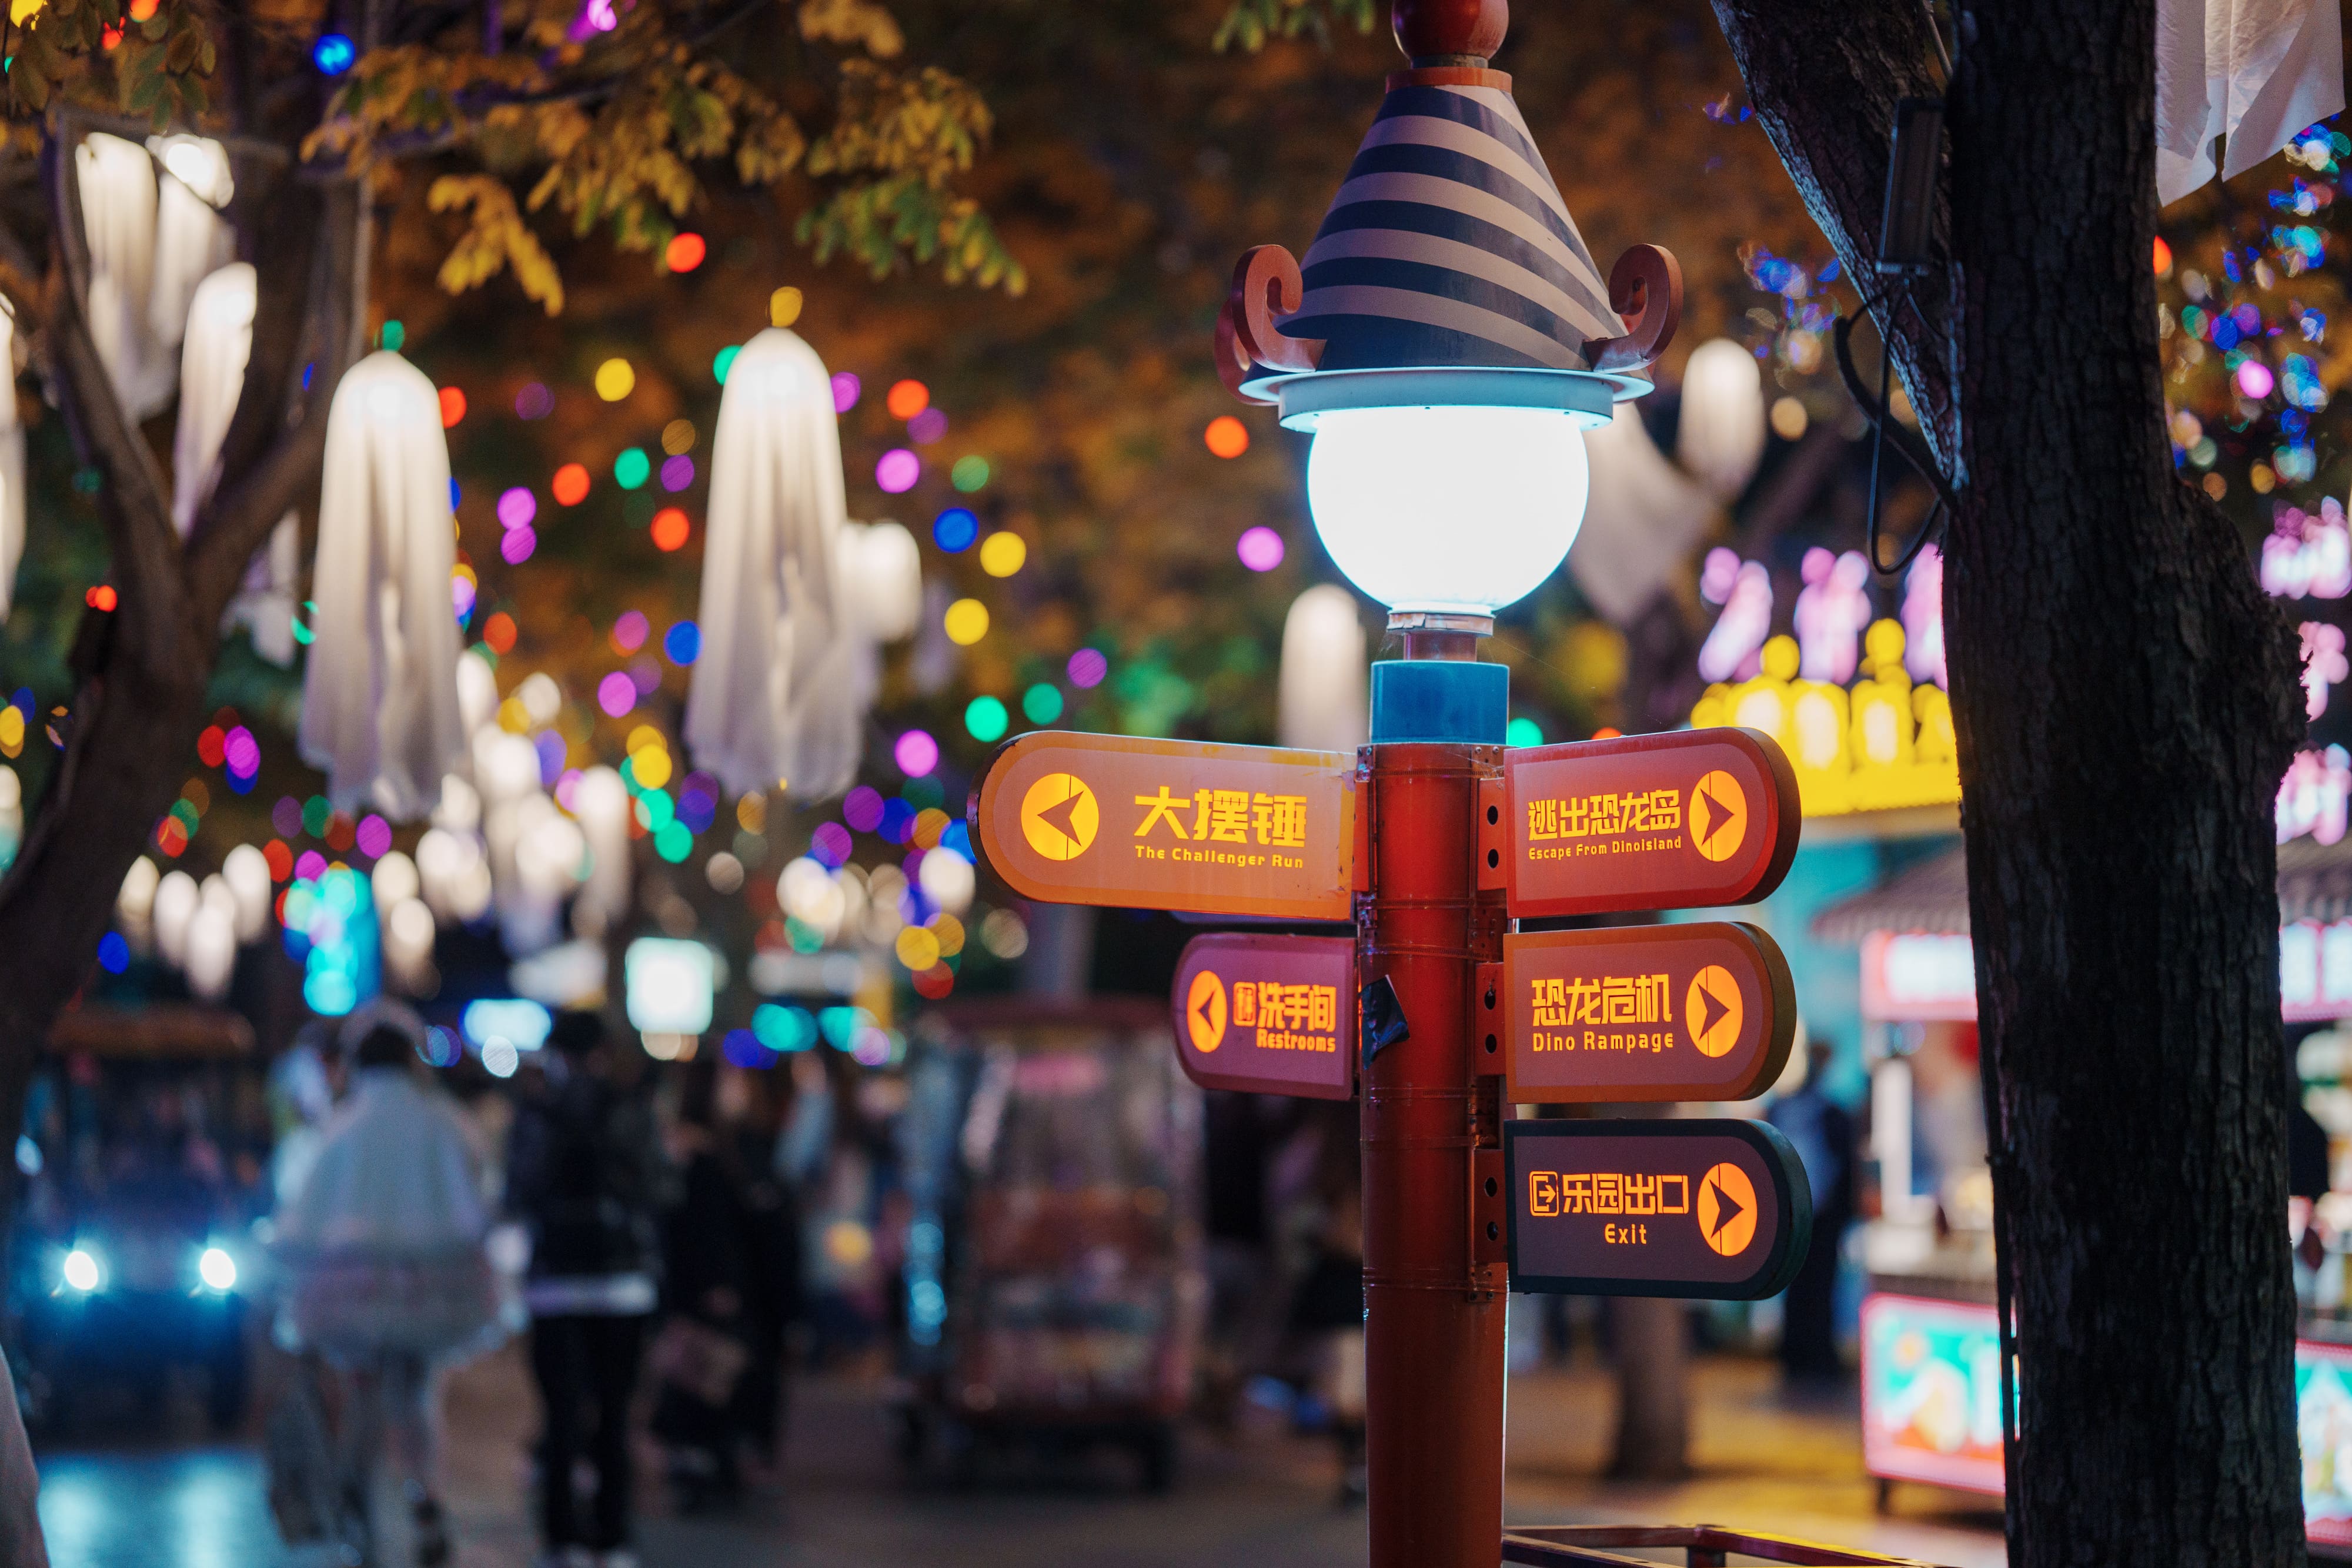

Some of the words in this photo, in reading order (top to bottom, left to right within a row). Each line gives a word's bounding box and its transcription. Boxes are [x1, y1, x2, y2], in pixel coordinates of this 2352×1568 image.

[1134, 786, 1307, 847] 大摆锤
[1527, 789, 1681, 841] 逃出恐龙岛
[1135, 845, 1165, 859] The
[1172, 848, 1265, 867] Challenger
[1272, 854, 1304, 869] Run
[1528, 847, 1572, 861] Escape
[1576, 843, 1607, 856] From
[1612, 835, 1681, 854] Dinoisland
[1257, 981, 1337, 1032] 洗手间
[1531, 973, 1673, 1027] 恐龙危机
[1256, 1028, 1336, 1053] Restrooms
[1533, 1032, 1576, 1052] Dino
[1583, 1031, 1673, 1054] Rampage
[1562, 1172, 1689, 1215] 乐园出口
[1604, 1222, 1648, 1245] Exit
